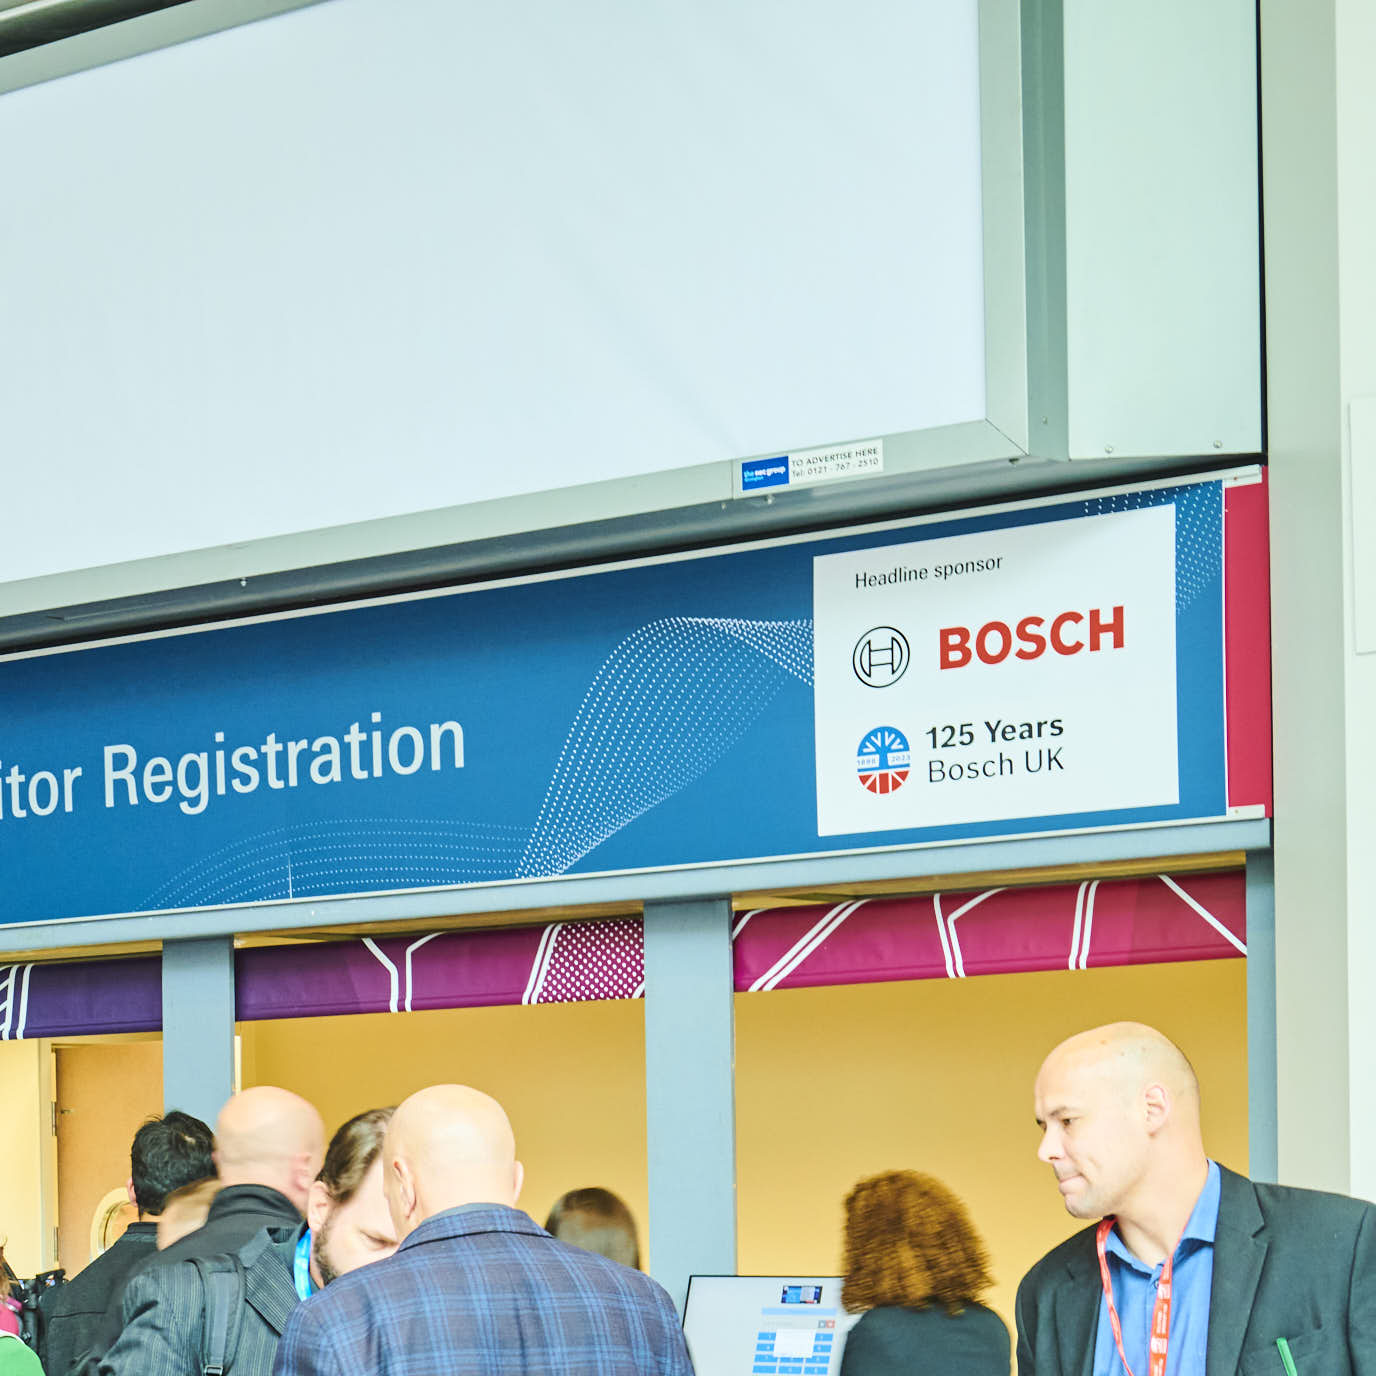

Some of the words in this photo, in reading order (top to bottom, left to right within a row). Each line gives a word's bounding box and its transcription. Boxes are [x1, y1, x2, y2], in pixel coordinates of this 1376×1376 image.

[807, 451, 852, 465] ADVERTISE
[855, 447, 878, 457] HERE
[855, 564, 928, 589] Headline
[933, 554, 1004, 579] sponsor
[939, 605, 1125, 670] BOSCH
[926, 722, 974, 750] 125
[984, 717, 1065, 744] Years
[103, 711, 466, 815] Registration
[928, 752, 1014, 783] Bosch
[1025, 747, 1065, 772] UK
